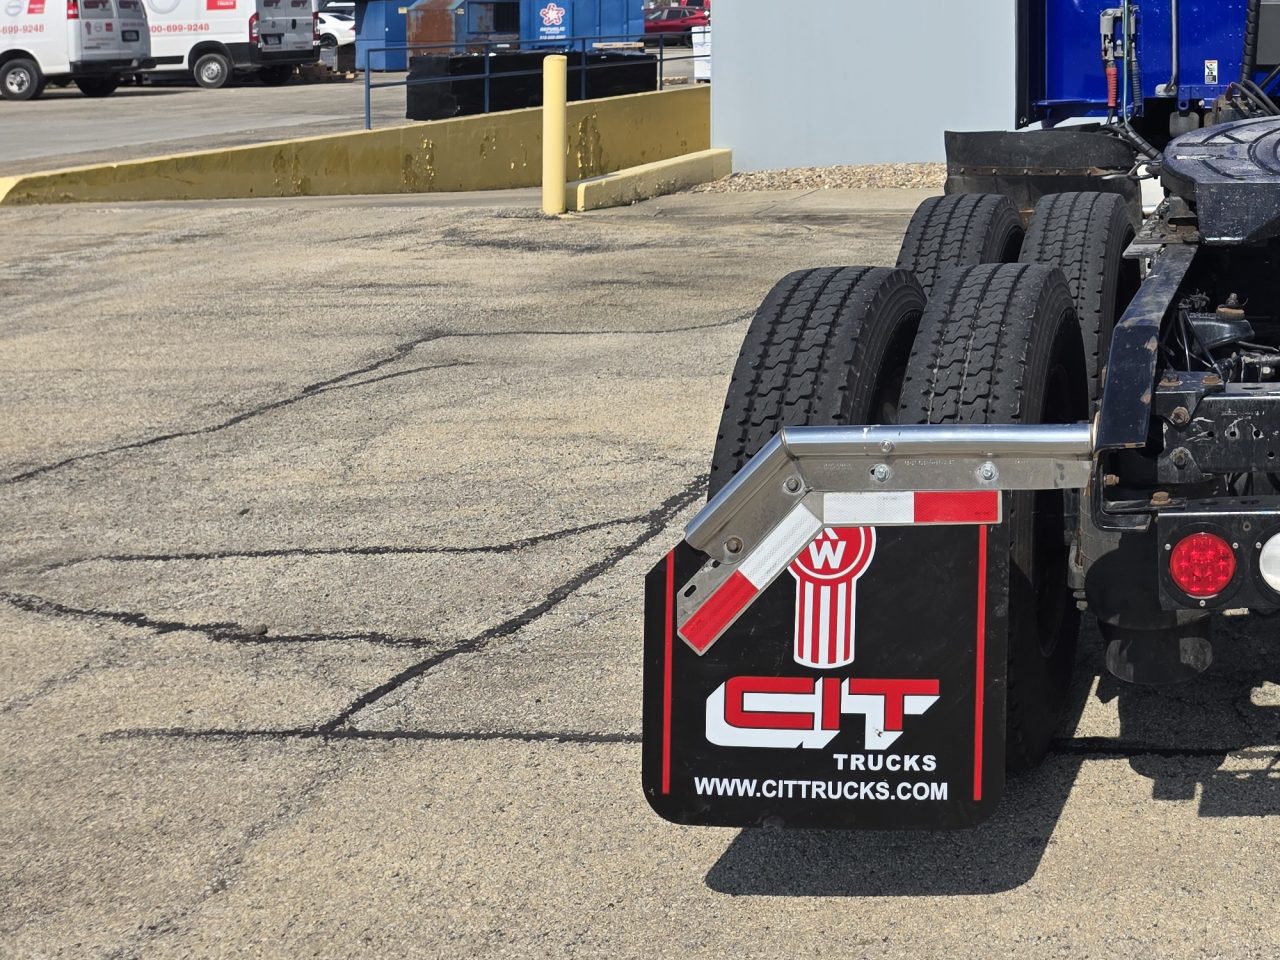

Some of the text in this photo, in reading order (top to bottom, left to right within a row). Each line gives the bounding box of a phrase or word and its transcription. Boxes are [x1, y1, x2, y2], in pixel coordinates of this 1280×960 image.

[706, 676, 940, 749] CIT
[833, 753, 937, 771] TRUCKS
[694, 776, 948, 801] WWW.CITTRUCKS.COM
